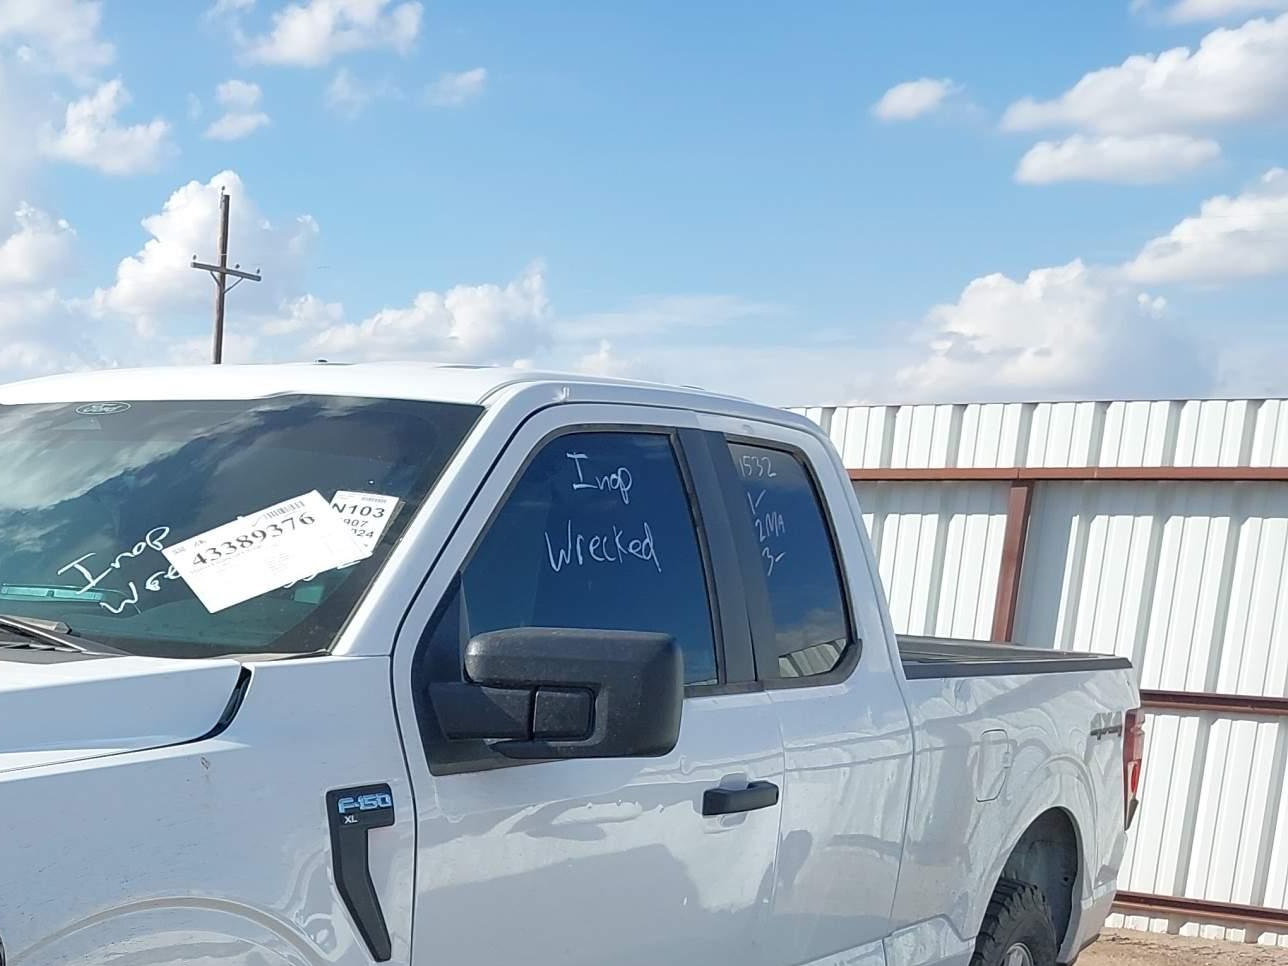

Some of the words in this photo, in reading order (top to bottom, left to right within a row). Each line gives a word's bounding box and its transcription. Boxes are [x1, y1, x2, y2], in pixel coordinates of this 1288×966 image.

[566, 450, 632, 504] Inop
[332, 502, 386, 518] N103
[192, 512, 316, 565] 43389376
[544, 519, 662, 573] Wrecked
[337, 793, 393, 813] F-150
[344, 815, 359, 824] XL
